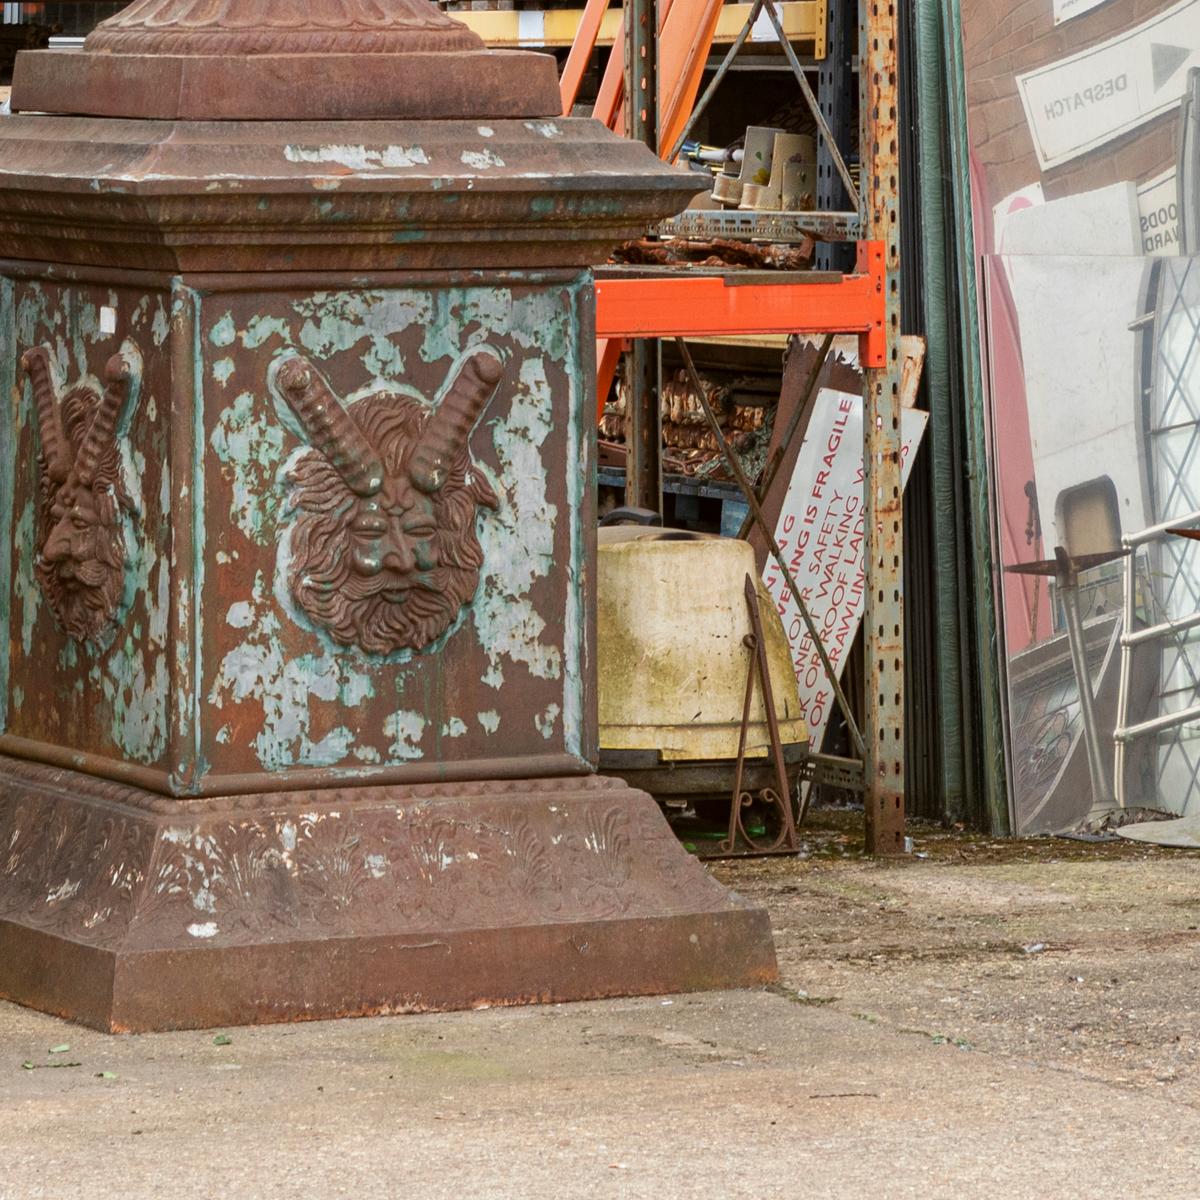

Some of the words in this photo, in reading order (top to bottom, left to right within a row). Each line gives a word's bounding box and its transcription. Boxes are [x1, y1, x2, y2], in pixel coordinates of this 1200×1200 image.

[804, 504, 818, 525] IS
[811, 399, 853, 499] FRAGILE
[809, 488, 843, 576] SAFETY
[815, 495, 859, 600] WALKING
[819, 571, 848, 643] ROOF
[810, 689, 830, 727] OR
